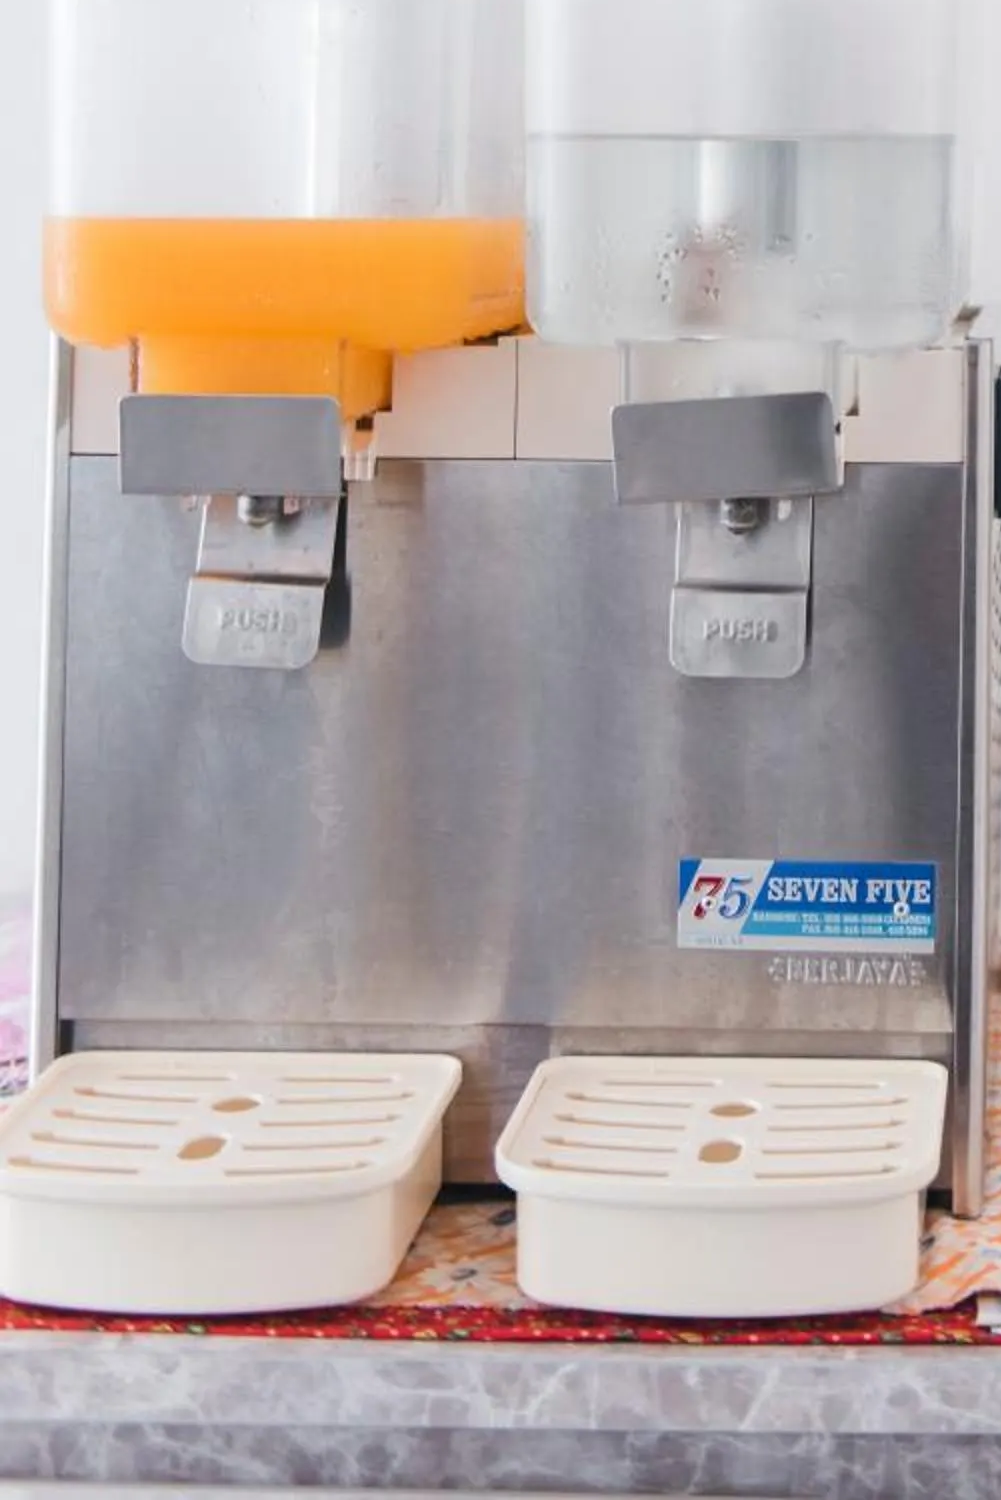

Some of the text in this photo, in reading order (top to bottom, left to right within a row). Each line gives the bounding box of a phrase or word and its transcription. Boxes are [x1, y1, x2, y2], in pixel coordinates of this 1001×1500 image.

[217, 607, 284, 632] PUSH
[702, 619, 769, 641] PUSH
[693, 876, 753, 920] 75
[767, 877, 931, 904] SEVEN FIVE
